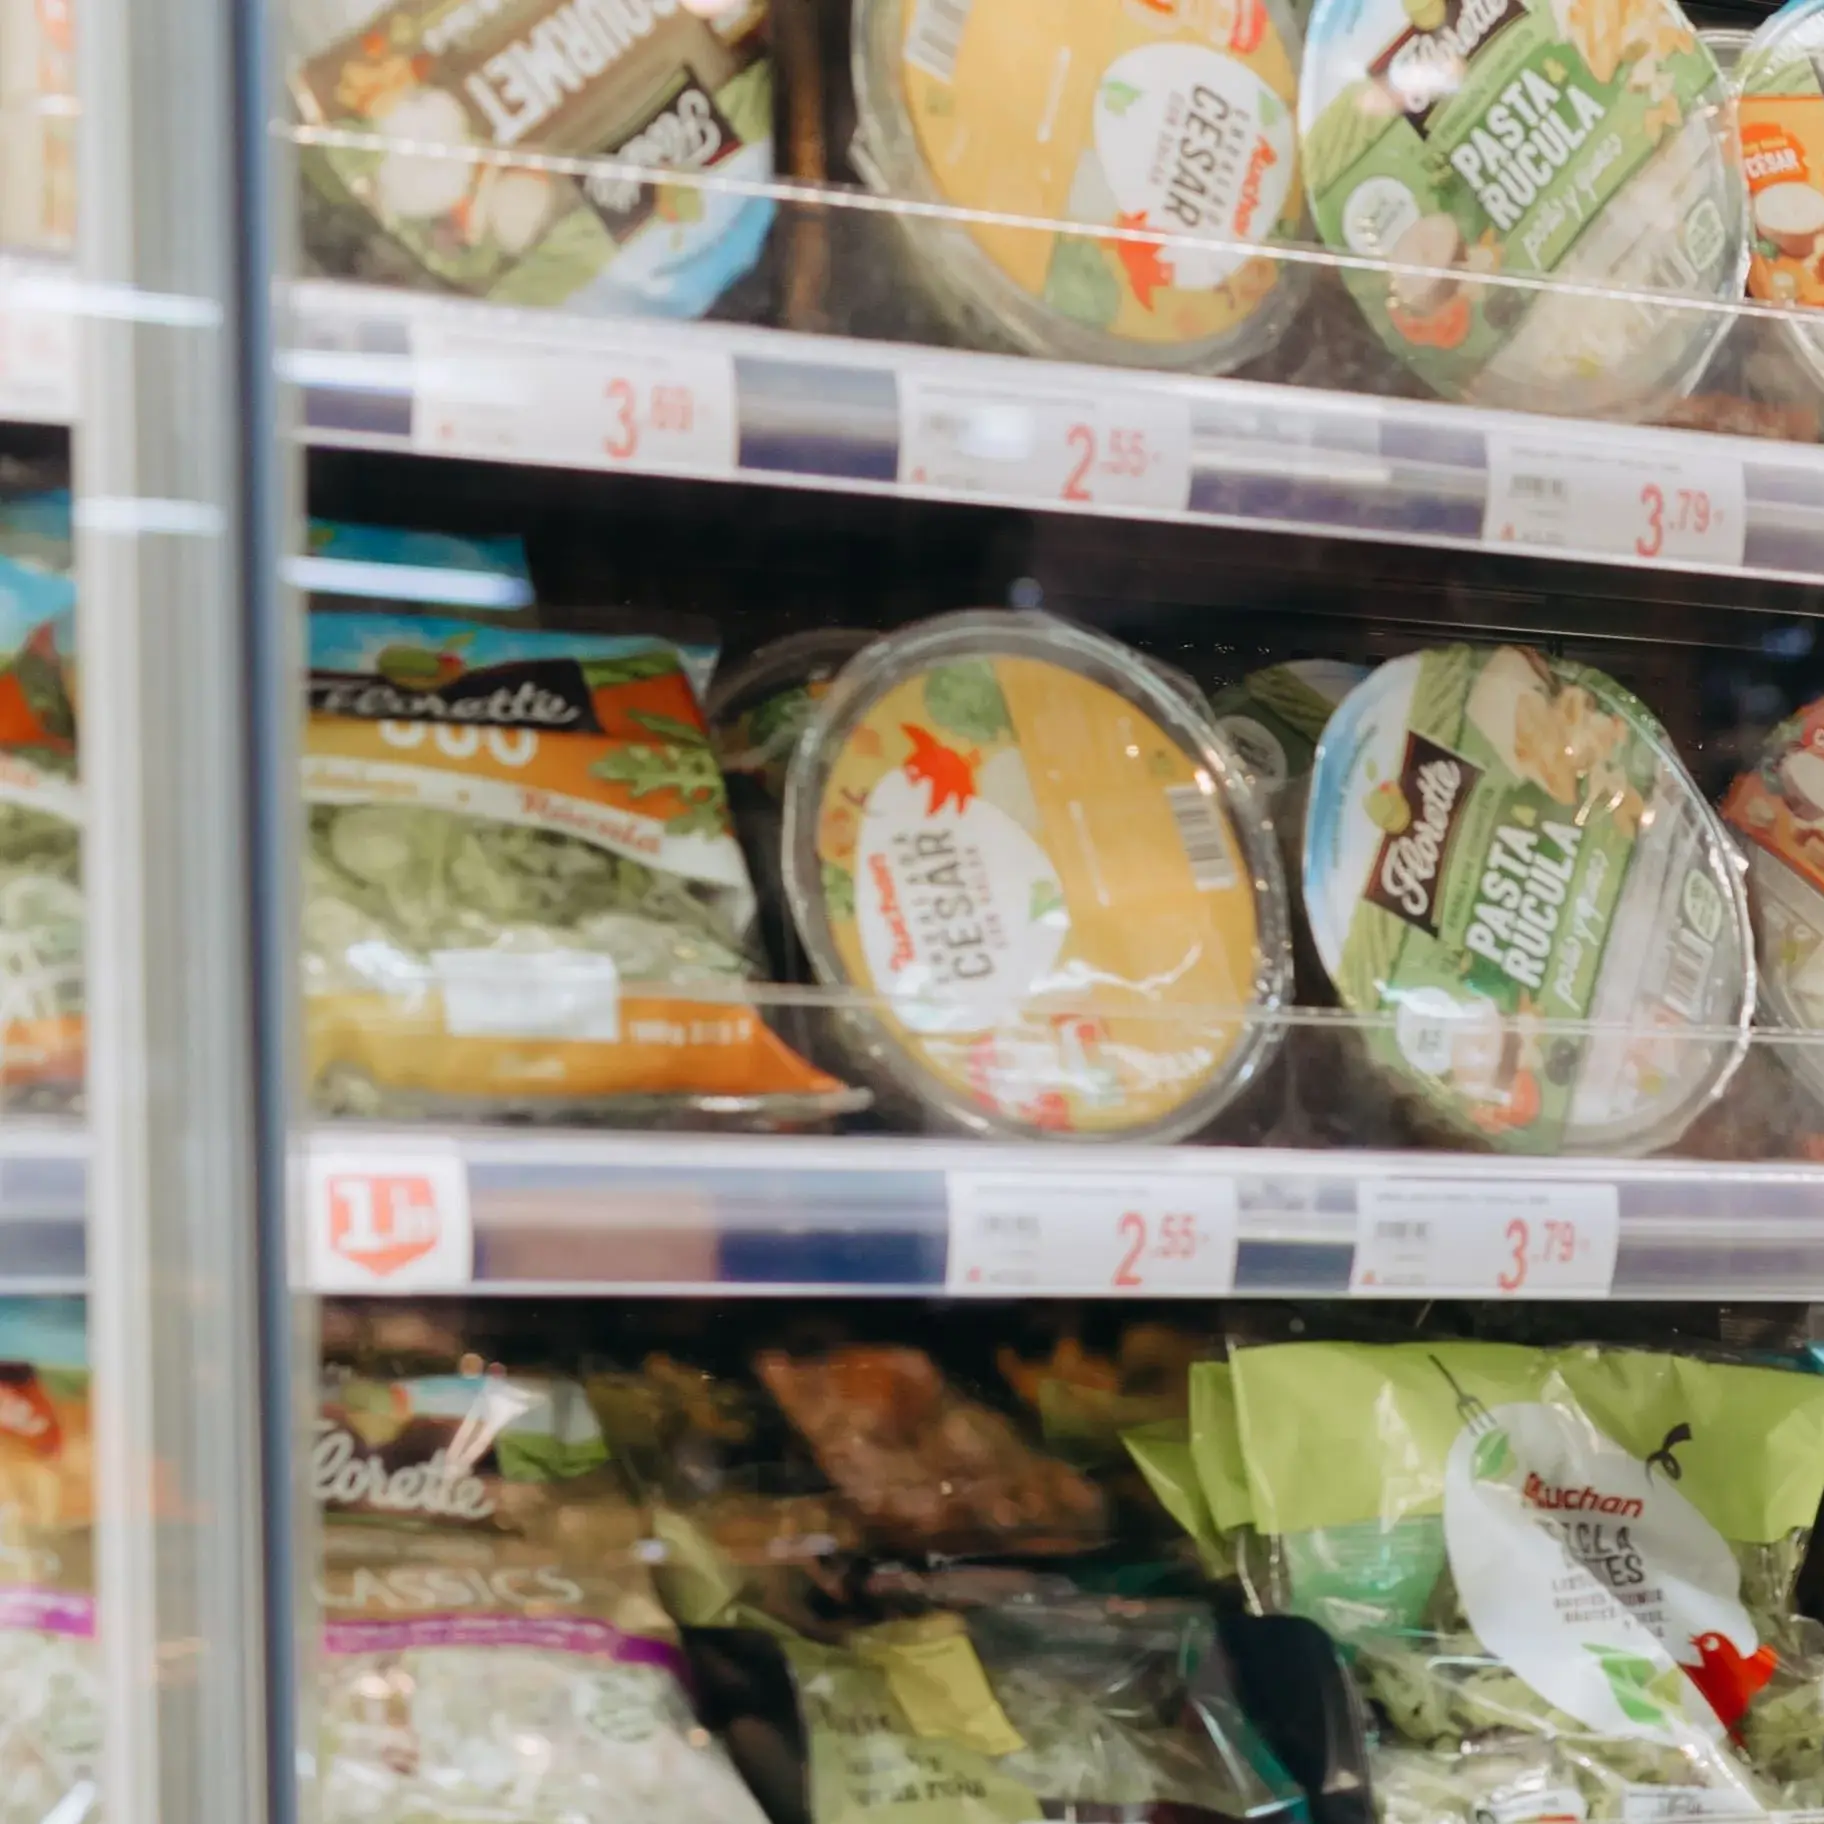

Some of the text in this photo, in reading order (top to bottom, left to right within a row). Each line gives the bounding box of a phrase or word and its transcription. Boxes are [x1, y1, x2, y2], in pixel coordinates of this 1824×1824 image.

[465, 0, 680, 146] OURMET
[1163, 83, 1232, 231] CESAR
[1451, 68, 1562, 189] PASTA
[1744, 143, 1800, 182] CÉSAR
[1635, 481, 1712, 559] 3.79
[1381, 759, 1461, 918] Florette
[1464, 823, 1539, 963] PASTA
[914, 828, 994, 982] CESAR
[1112, 1211, 1198, 1286] 2.55
[1498, 1216, 1577, 1292] 3.79
[309, 1420, 495, 1517] lorette
[1523, 1471, 1644, 1520] Auchan
